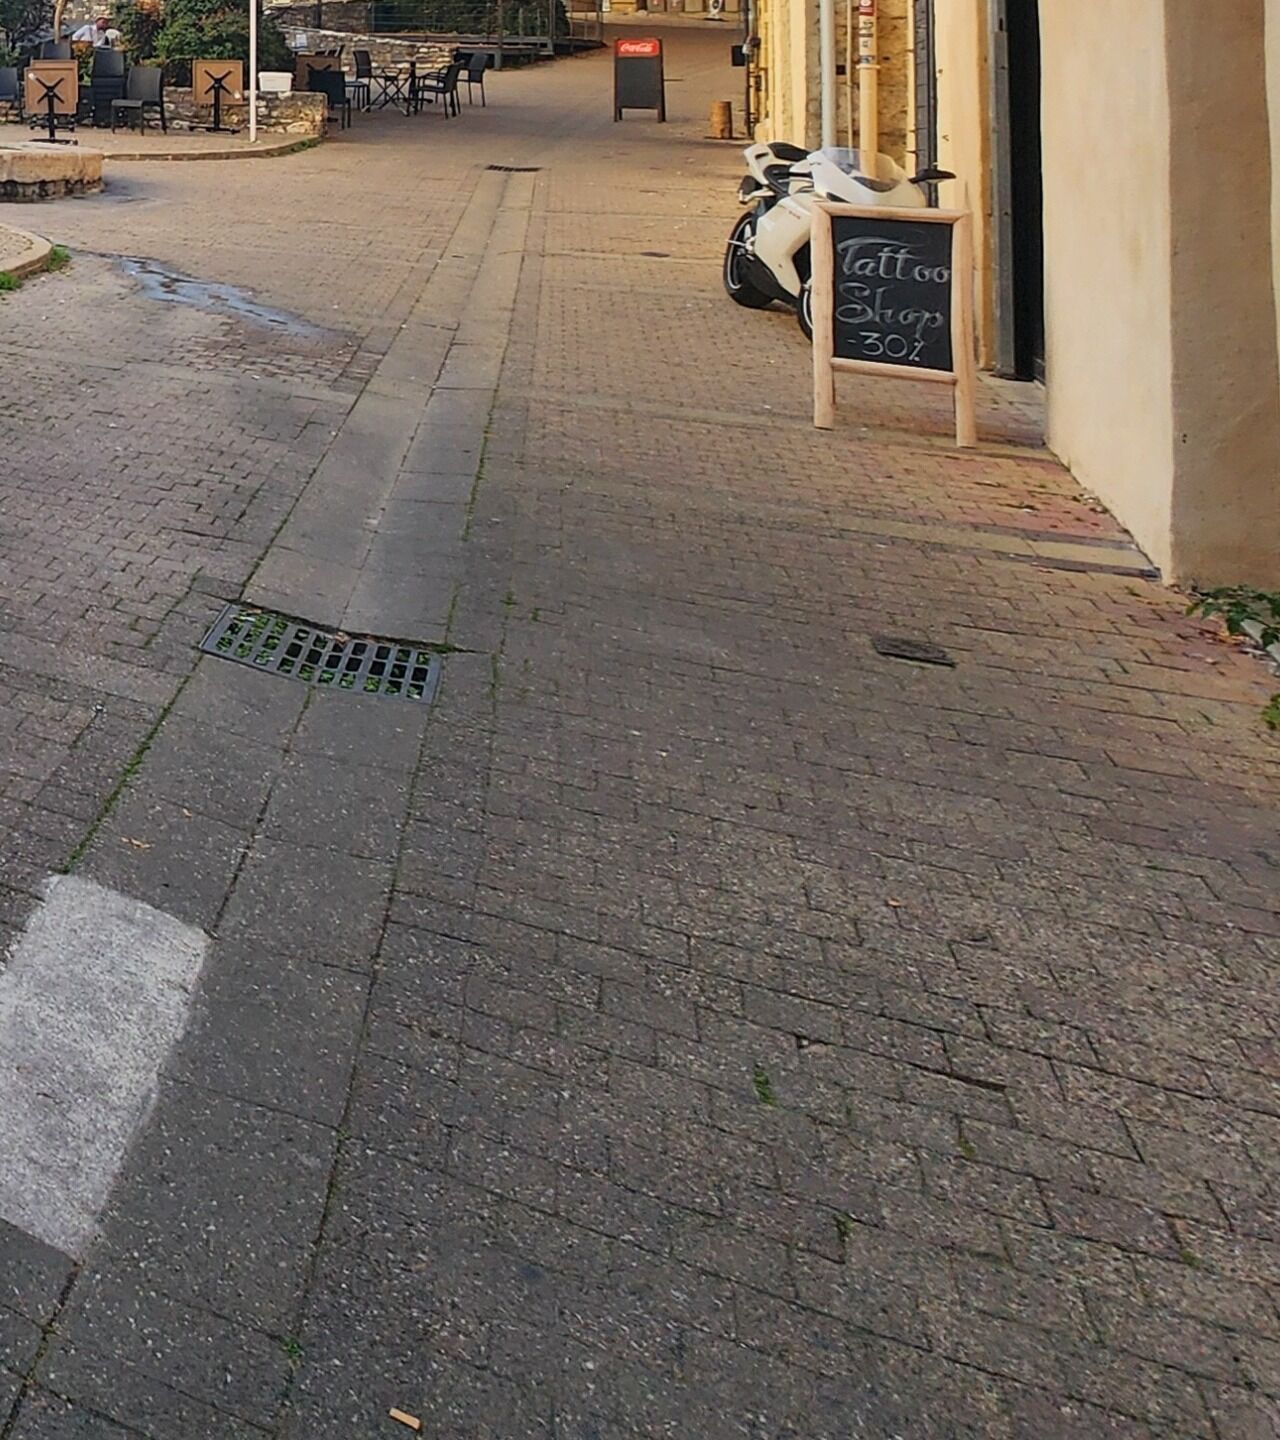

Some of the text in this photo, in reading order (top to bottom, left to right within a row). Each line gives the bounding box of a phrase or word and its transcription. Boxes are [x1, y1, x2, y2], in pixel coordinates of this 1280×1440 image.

[837, 236, 951, 283] Tattoo
[835, 281, 944, 340] Shop
[847, 331, 924, 362] -30%
